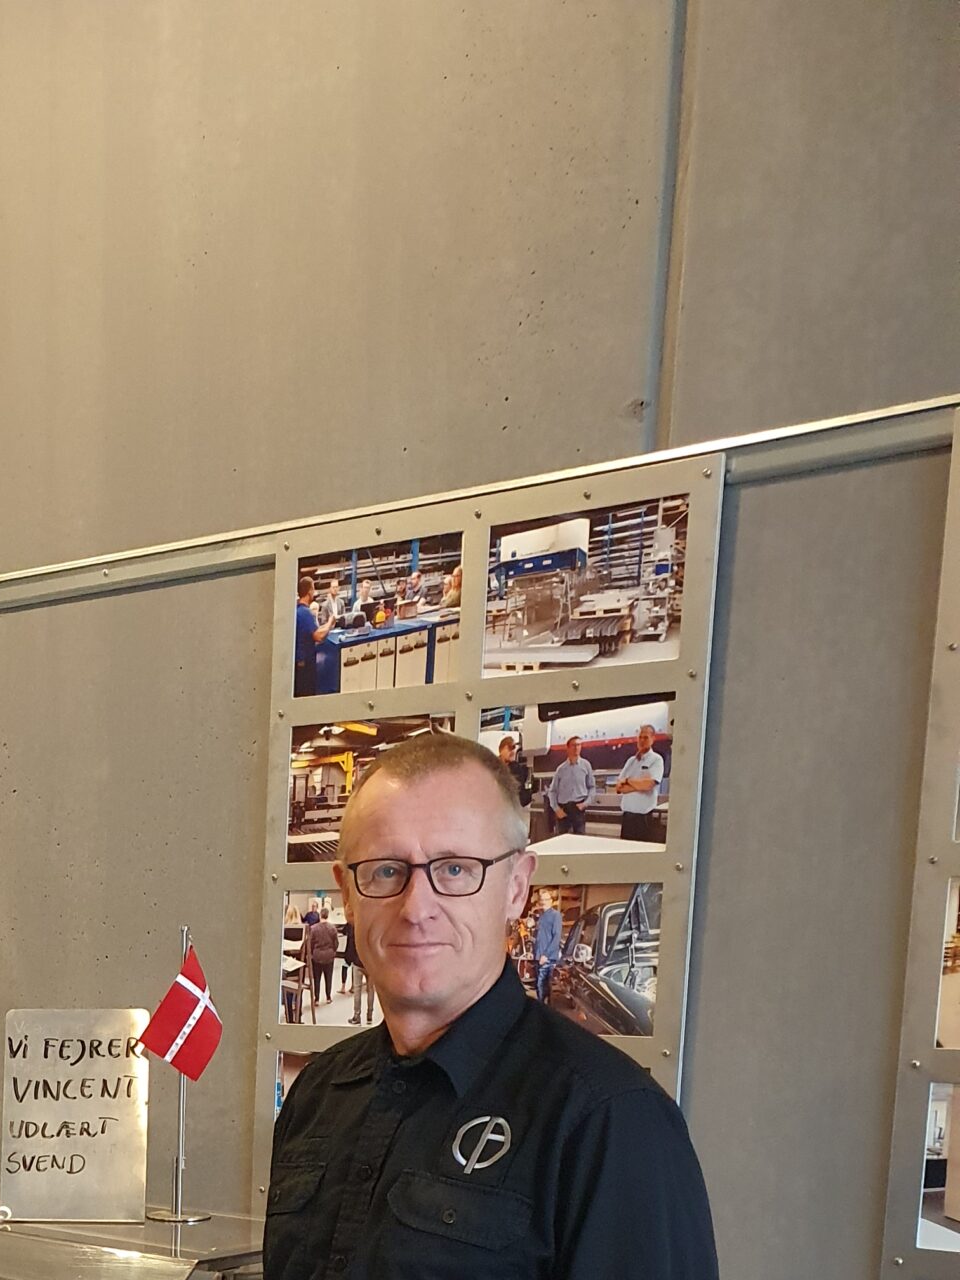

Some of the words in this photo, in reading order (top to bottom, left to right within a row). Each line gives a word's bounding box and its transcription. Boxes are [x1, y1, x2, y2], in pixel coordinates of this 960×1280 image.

[43, 1037, 141, 1066] FEJRER
[12, 1074, 138, 1103] VINCENT
[9, 1116, 119, 1138] UDLÆRT
[5, 1151, 86, 1174] SVEND
